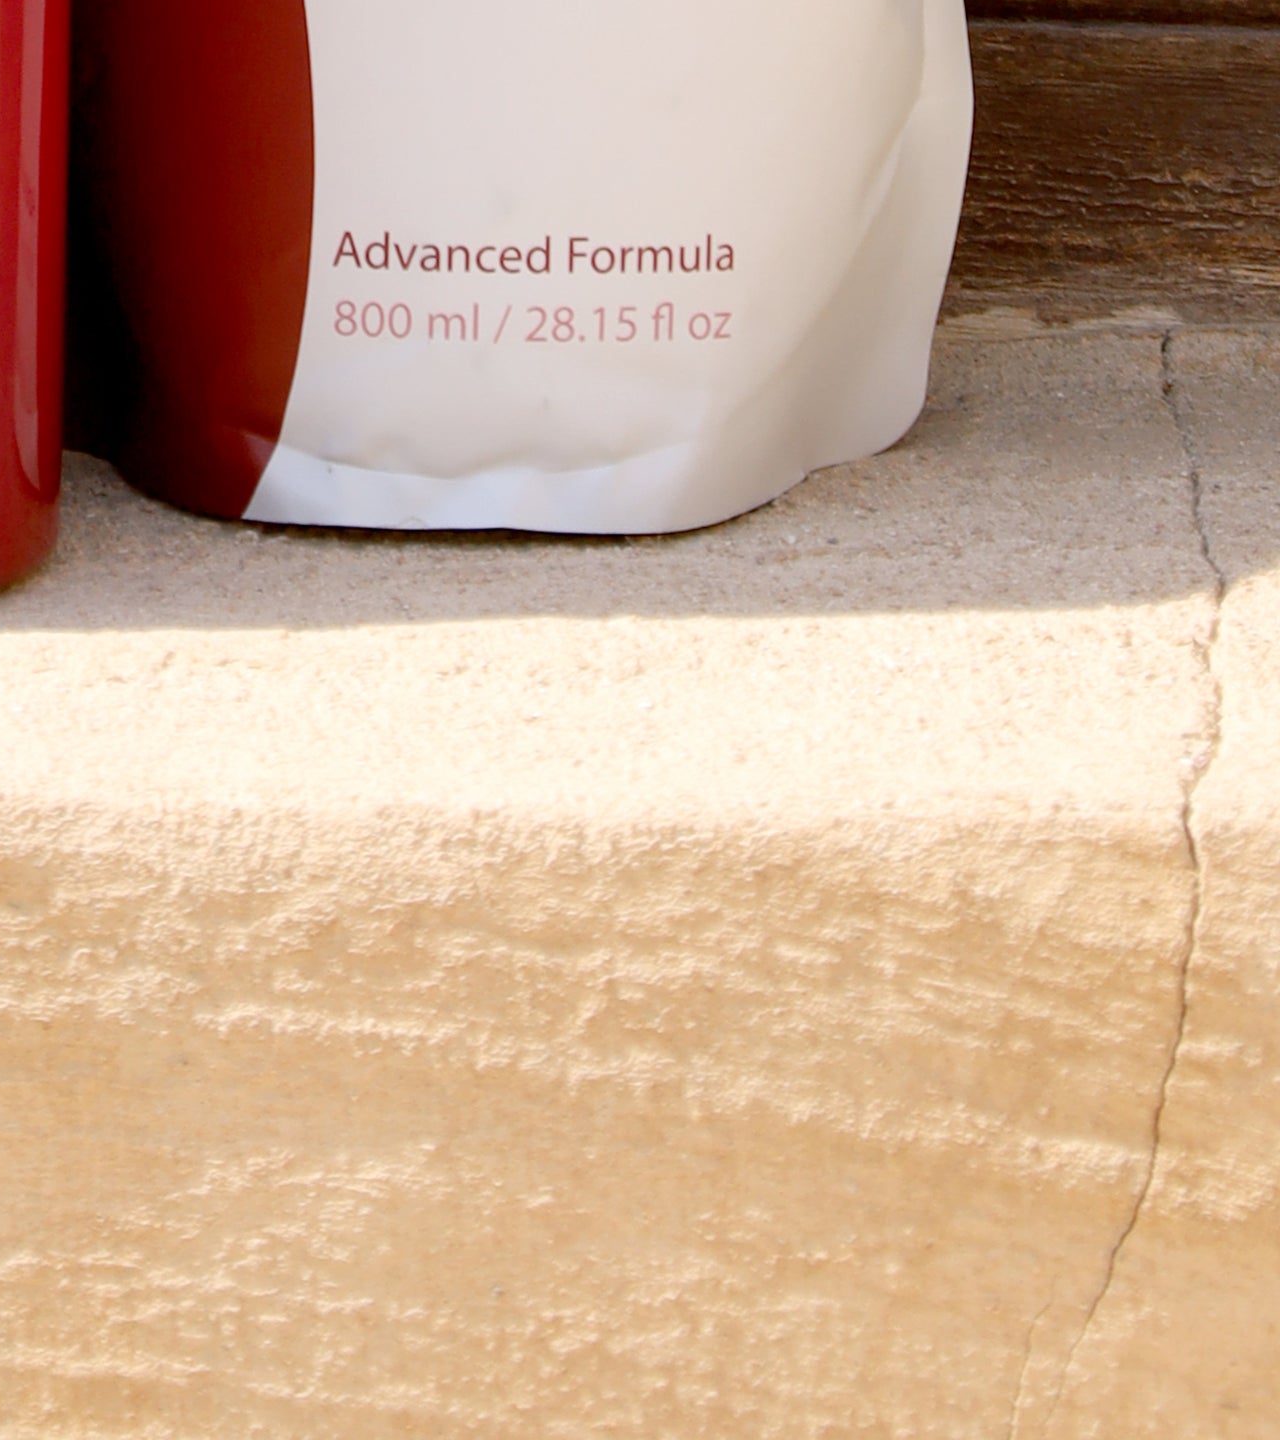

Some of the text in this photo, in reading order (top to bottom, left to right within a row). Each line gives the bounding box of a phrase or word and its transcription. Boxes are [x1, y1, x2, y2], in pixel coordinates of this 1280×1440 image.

[333, 231, 735, 274] Advanced Formula
[333, 300, 413, 340] 800
[427, 304, 480, 342] ml
[525, 306, 637, 344] 28.15
[650, 302, 675, 342] fl
[688, 309, 733, 341] oz
